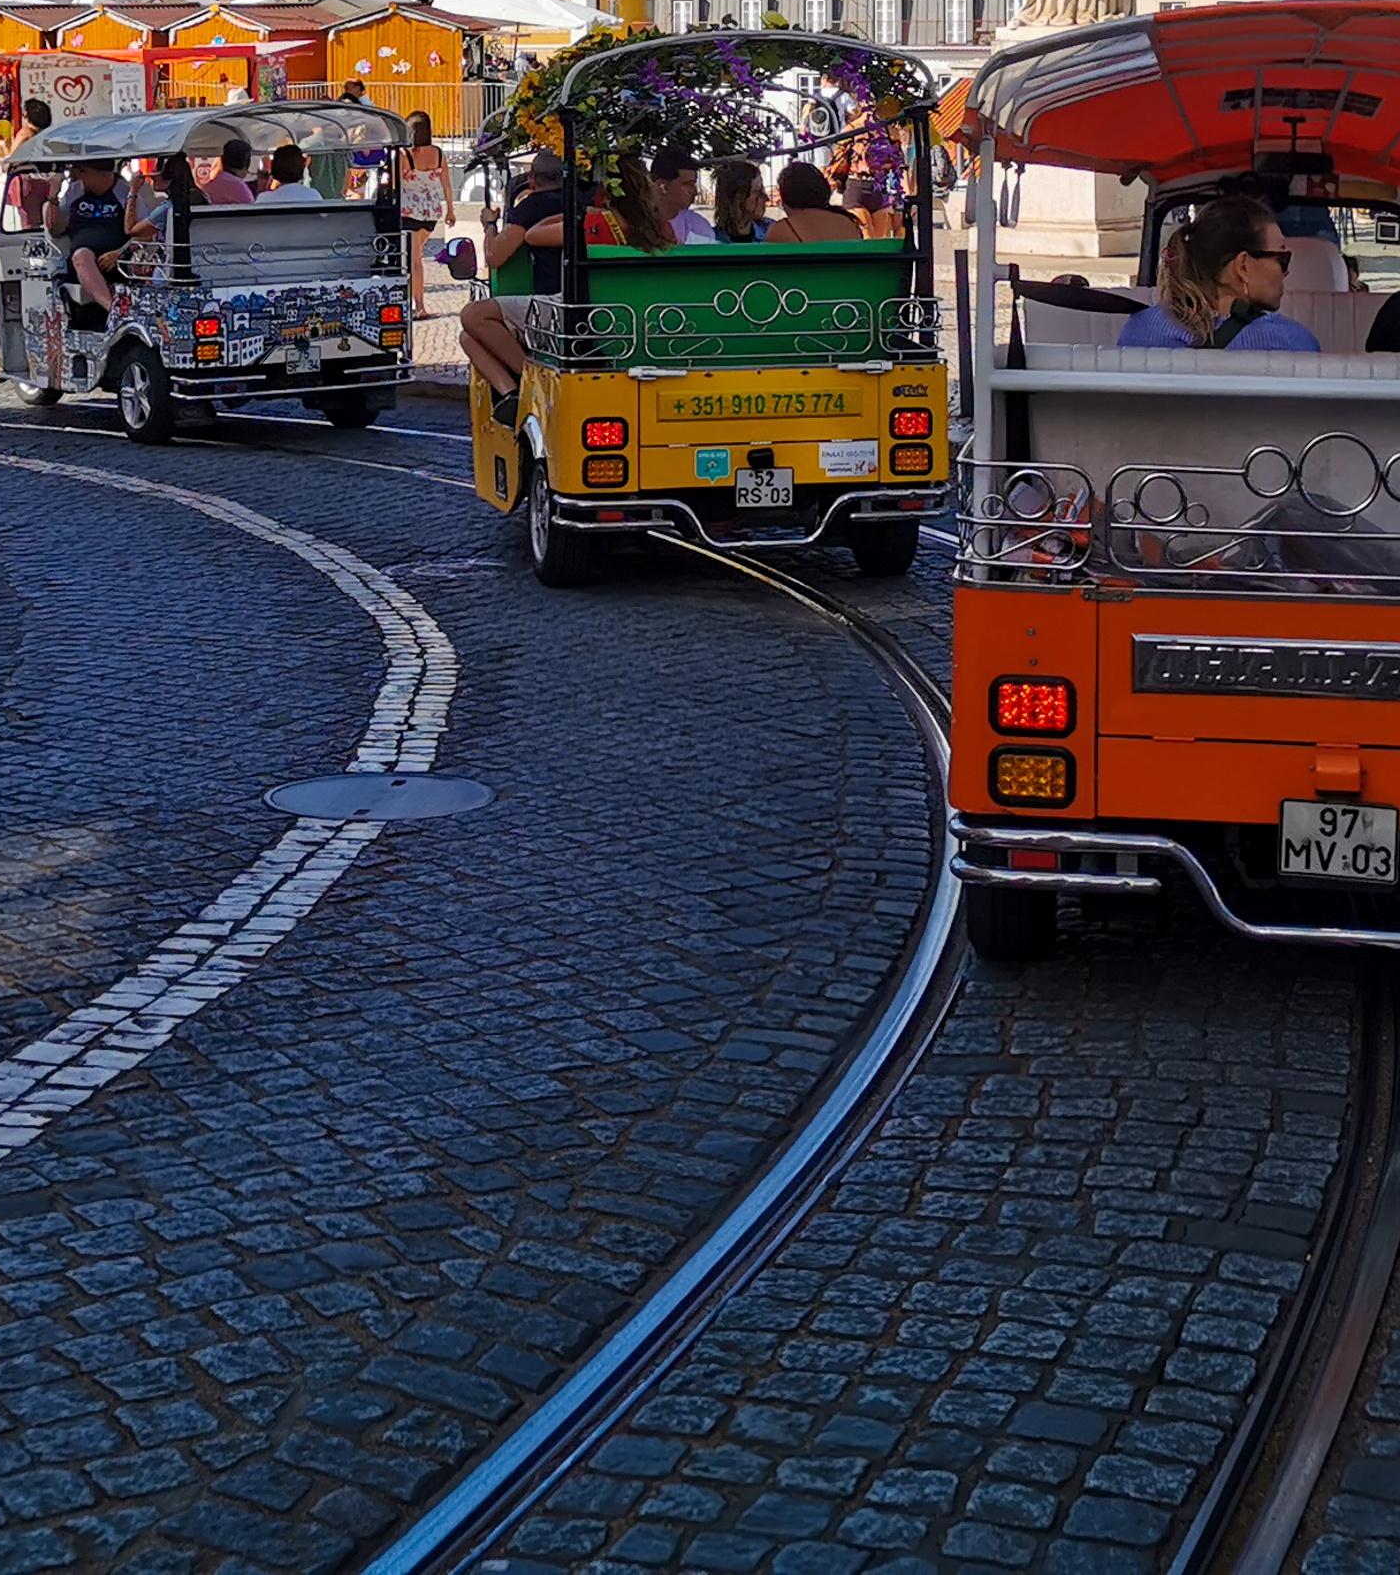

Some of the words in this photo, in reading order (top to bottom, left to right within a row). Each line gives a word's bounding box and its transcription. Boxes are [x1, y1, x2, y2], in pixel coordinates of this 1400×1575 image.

[63, 102, 87, 117] OLÁ
[691, 395, 723, 416] 351
[732, 394, 766, 415] 910
[772, 393, 805, 414] 775
[812, 392, 845, 413] 774
[754, 471, 775, 487] 52
[1318, 807, 1360, 839] 97
